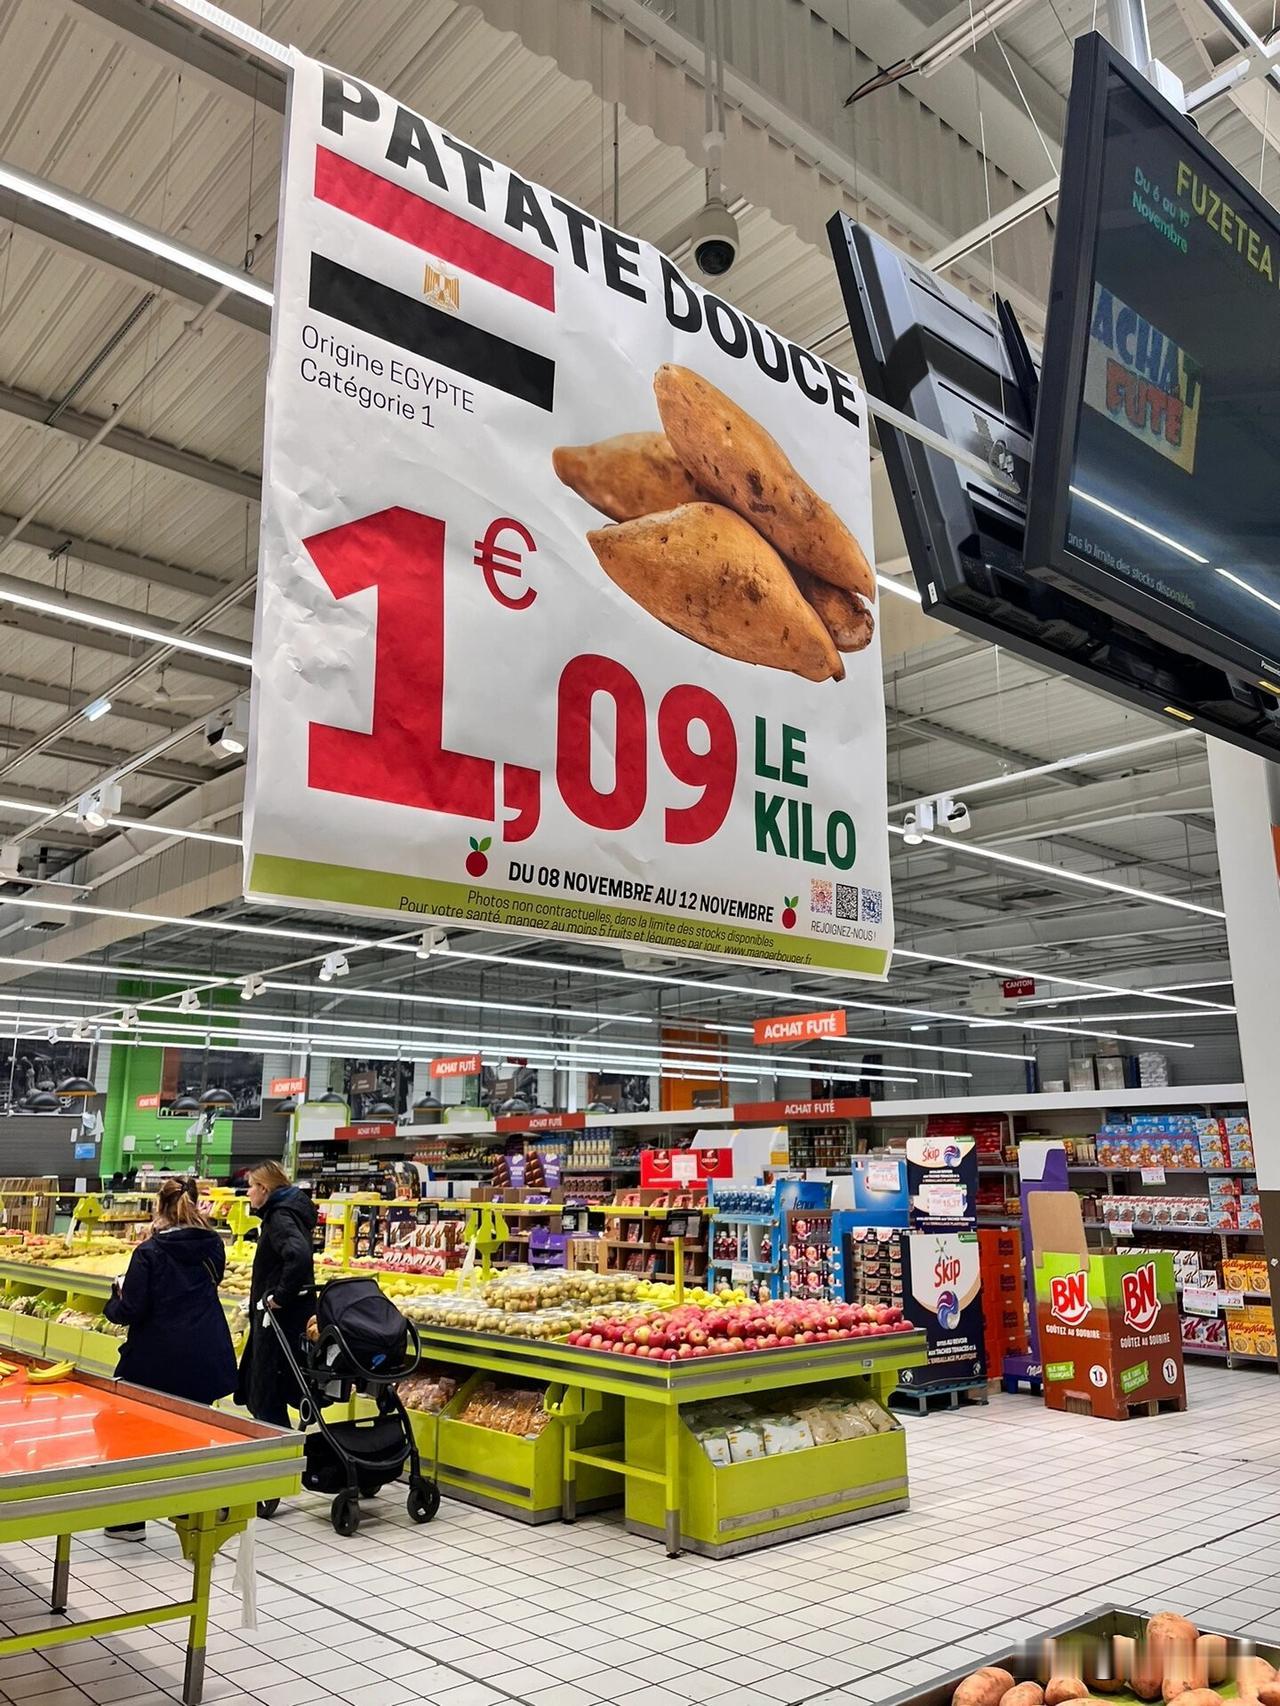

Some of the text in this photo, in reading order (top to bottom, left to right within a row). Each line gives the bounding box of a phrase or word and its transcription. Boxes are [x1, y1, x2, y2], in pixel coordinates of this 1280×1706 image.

[322, 68, 860, 427] PATATE DOUCE
[1131, 190, 1189, 254] Novembre
[302, 325, 474, 414] Origine EGYPTE
[1090, 286, 1201, 410] ACHAT
[300, 358, 435, 428] Catégorie 1
[473, 517, 537, 610] €
[755, 716, 809, 787] LE
[755, 792, 858, 870] KILO
[399, 896, 428, 913] Pour
[430, 904, 465, 919] votre
[551, 919, 565, 932] au
[566, 922, 598, 937] moins
[599, 923, 607, 938] 5
[608, 925, 632, 940] fruits
[633, 931, 645, 942] et
[467, 890, 775, 949] Photos non contractuelles, dans la limite des stocks disponibles
[508, 861, 775, 924] DU 08 NOVEMBRE AU 12 NOVEMBRE
[1005, 980, 1033, 989] CANTON
[764, 1013, 837, 1039] ACHAT FUTÉ
[435, 1056, 477, 1074] ACHAT FUTÉ
[529, 1119, 548, 1128] ACHAT
[784, 1100, 836, 1114] ACHAT FUTÉ
[1051, 1274, 1086, 1313] BN
[1123, 1264, 1156, 1320] BN
[1046, 1324, 1101, 1339] GOÛTEZ AU SOURIRE
[1120, 1332, 1171, 1349] GOÛTEZ AU SOURIRE
